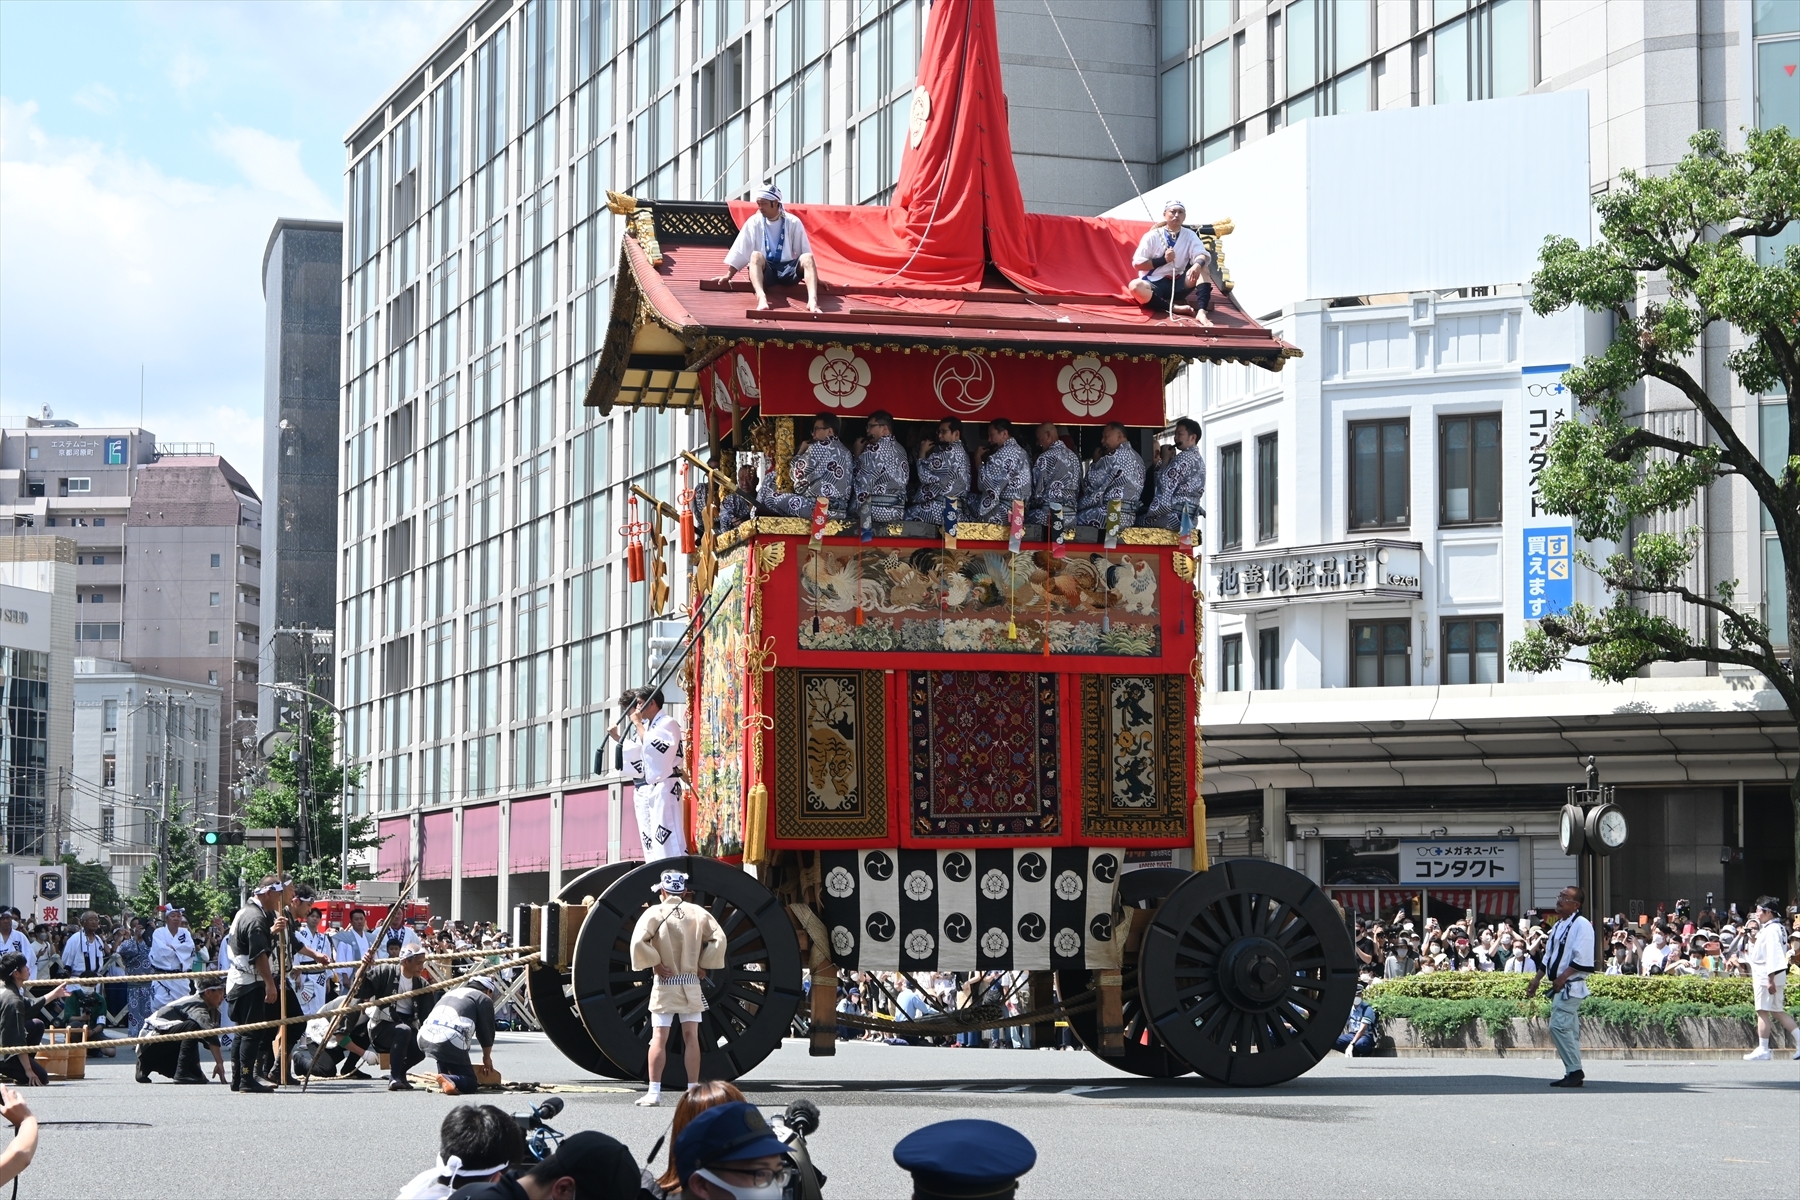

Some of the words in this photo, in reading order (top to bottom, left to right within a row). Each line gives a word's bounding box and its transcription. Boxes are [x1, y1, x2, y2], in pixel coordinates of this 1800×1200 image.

[51, 440, 99, 448] エステムコート
[58, 448, 94, 457] 京都河原町
[1549, 537, 1566, 578] すぐ
[1217, 555, 1367, 595] 池善化粧品店
[1527, 536, 1547, 616] 買えます
[1444, 846, 1505, 856] メガネスーパー
[1415, 859, 1505, 878] コンタクト
